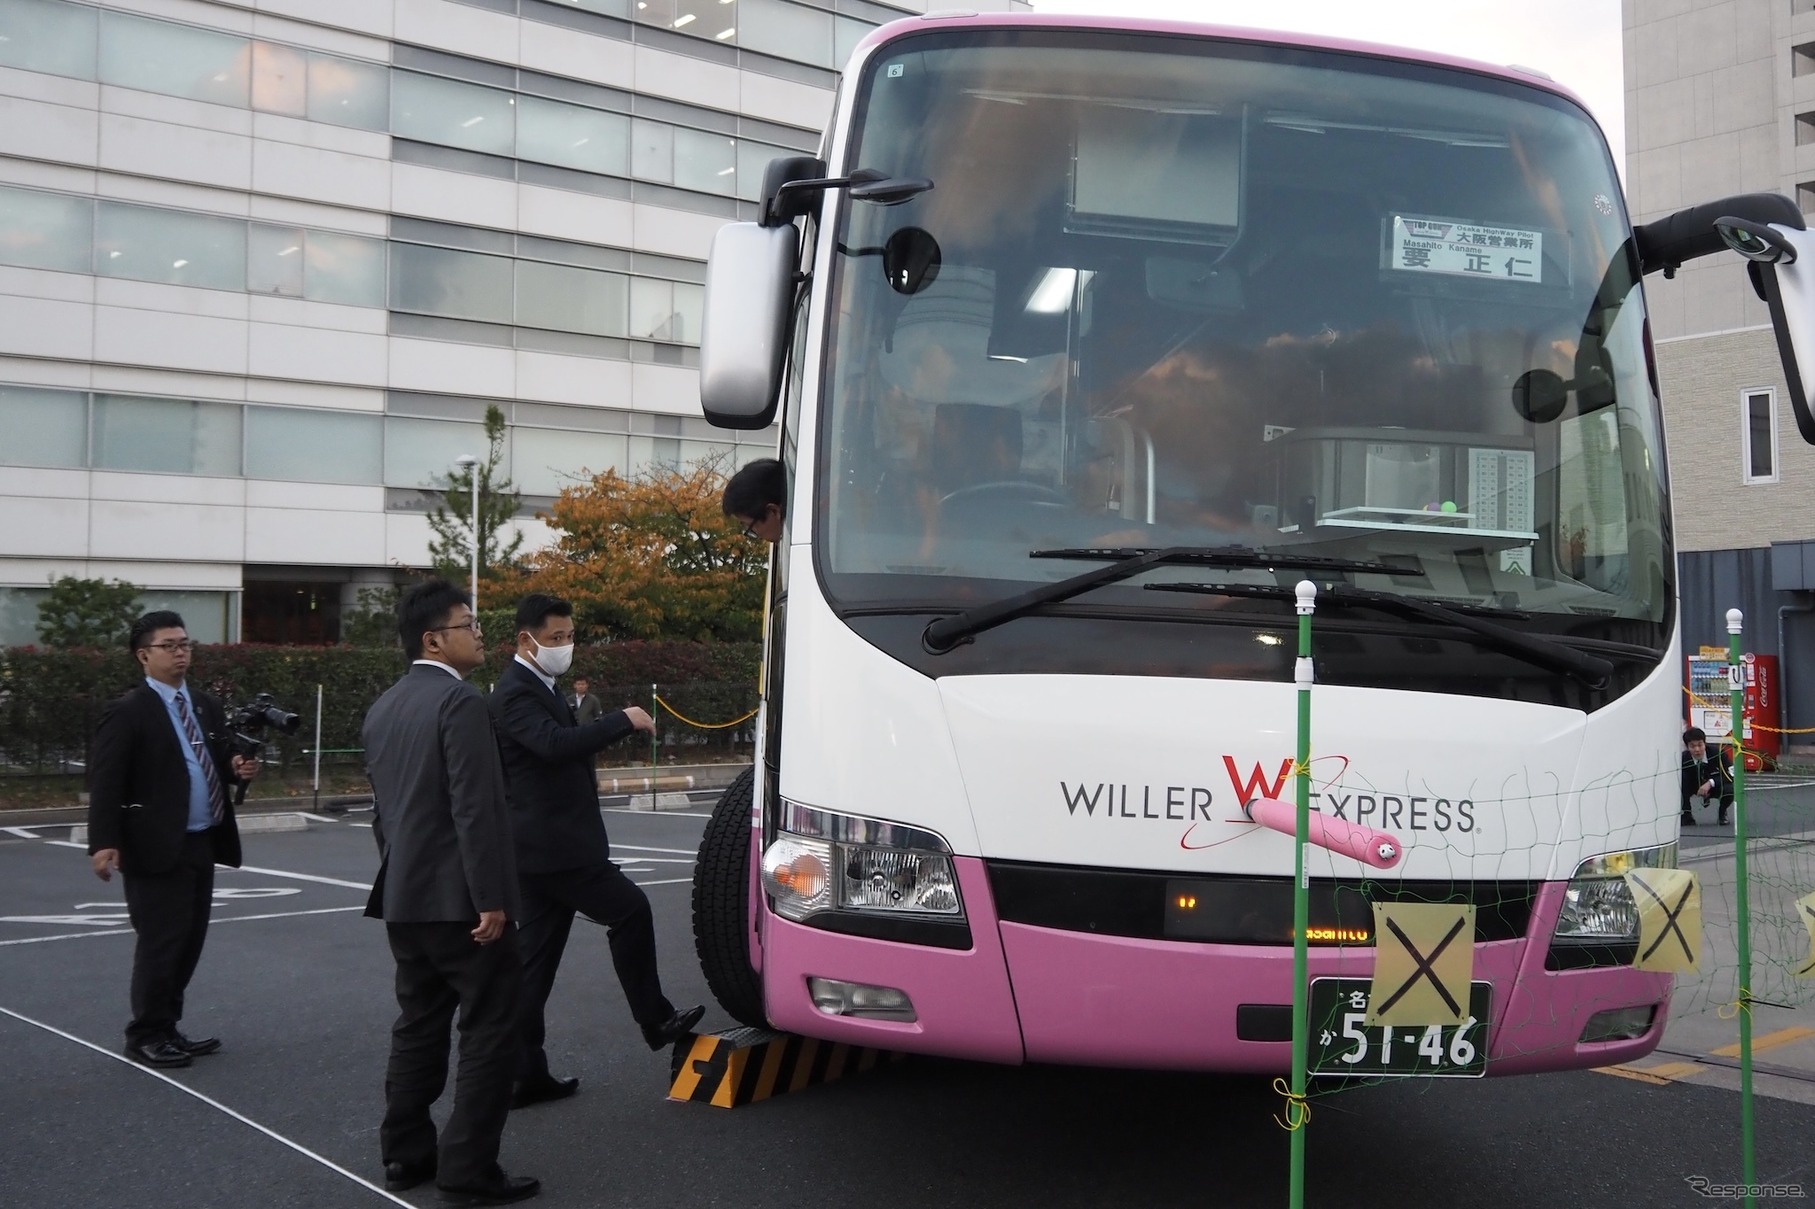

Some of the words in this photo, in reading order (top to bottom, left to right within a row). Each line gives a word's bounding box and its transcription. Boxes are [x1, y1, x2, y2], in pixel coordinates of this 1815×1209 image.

[1413, 221, 1428, 230] TOP
[1457, 225, 1482, 233] Osaka
[1517, 231, 1534, 239] Pilot
[1403, 239, 1443, 250] Masahito
[1449, 243, 1483, 254] Kaname
[1457, 233, 1534, 250] 大阪営業所
[1402, 246, 1431, 268] 要
[1060, 781, 1213, 821] WILLER
[1319, 1029, 1337, 1046] か
